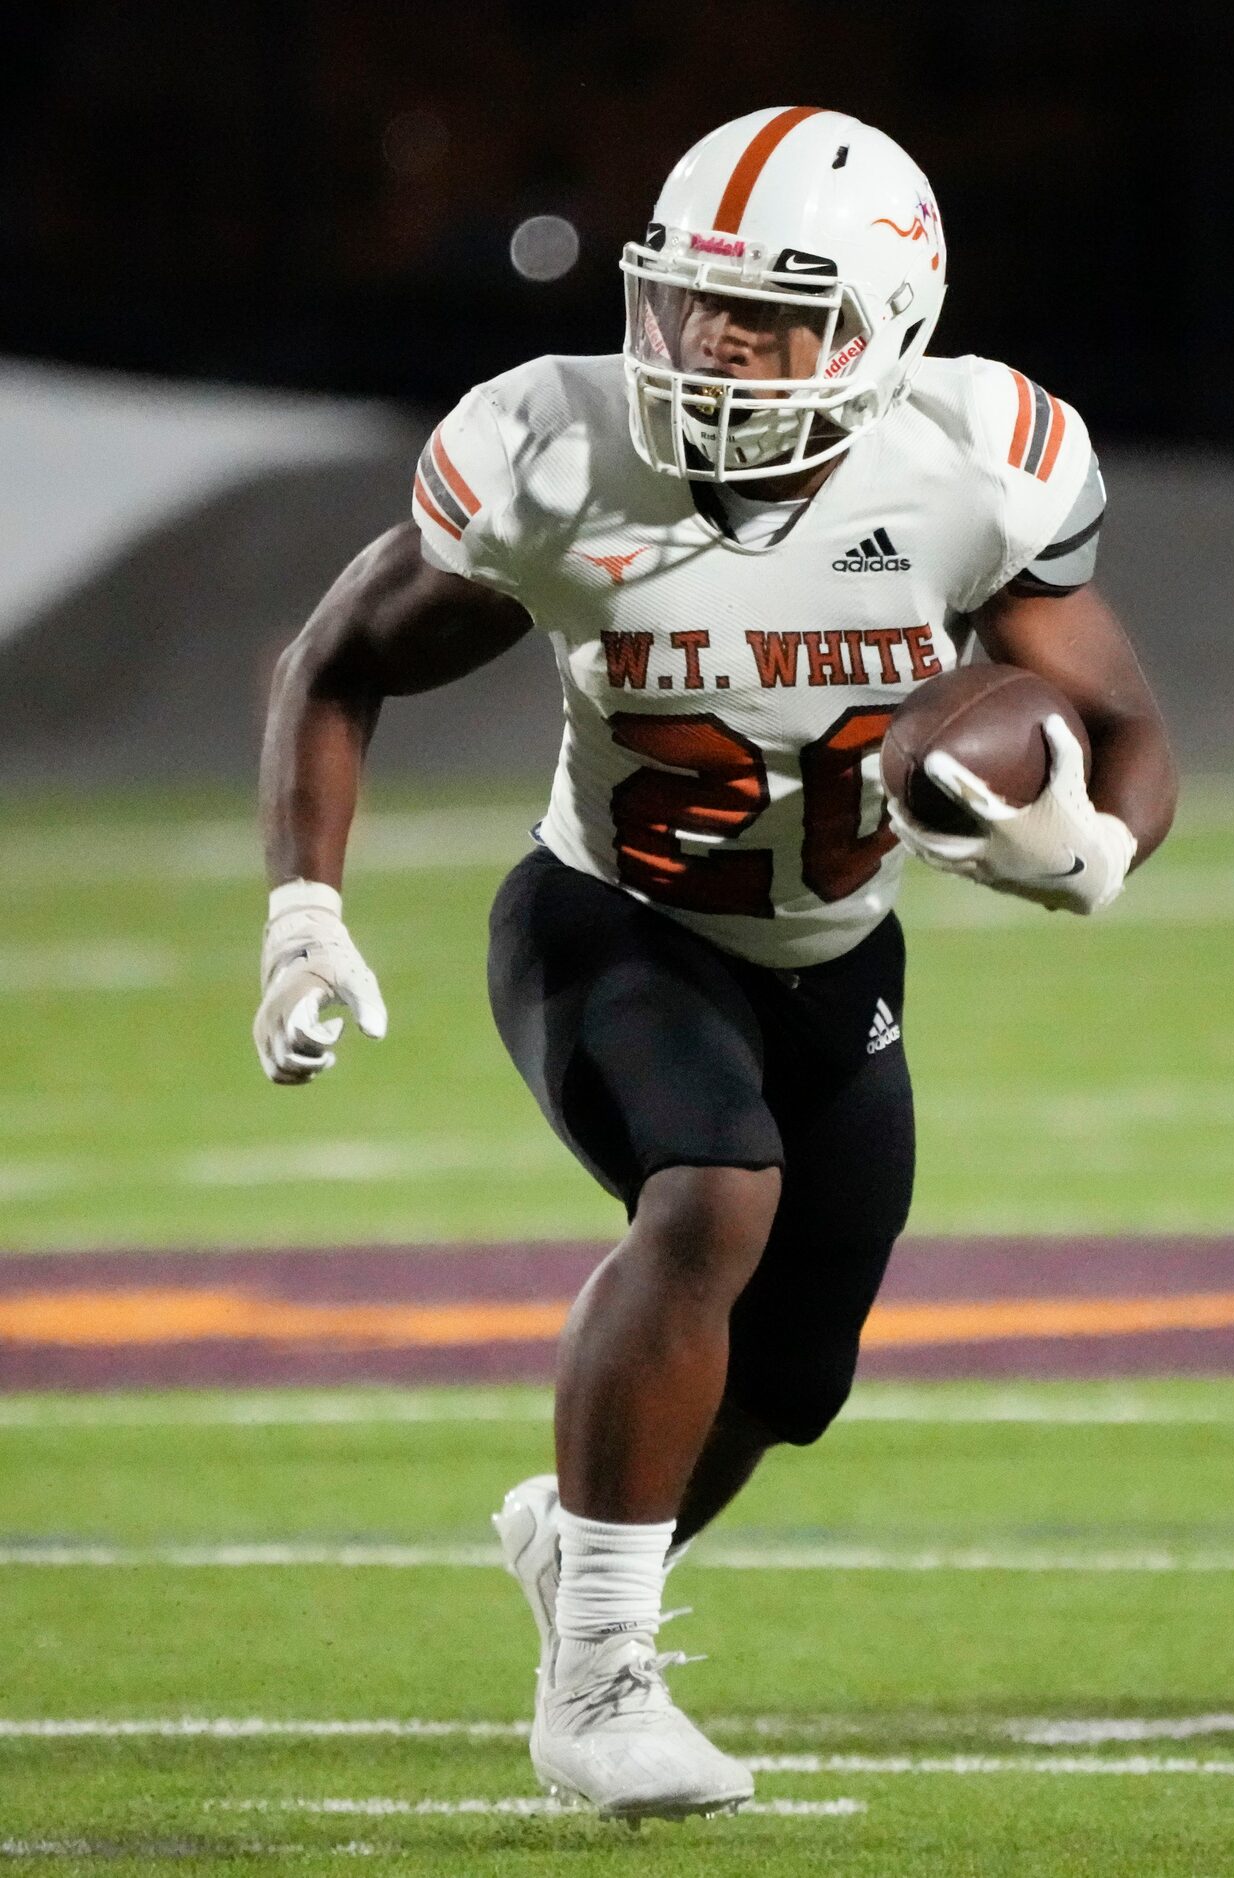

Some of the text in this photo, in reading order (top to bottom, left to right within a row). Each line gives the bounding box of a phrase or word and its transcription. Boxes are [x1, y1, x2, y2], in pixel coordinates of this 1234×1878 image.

[825, 335, 868, 378] iddell
[700, 431, 736, 443] Ridll
[831, 556, 912, 573] adidas
[601, 624, 943, 690] W.T. WHITE
[611, 703, 897, 919] 20
[866, 1024, 901, 1055] adidas
